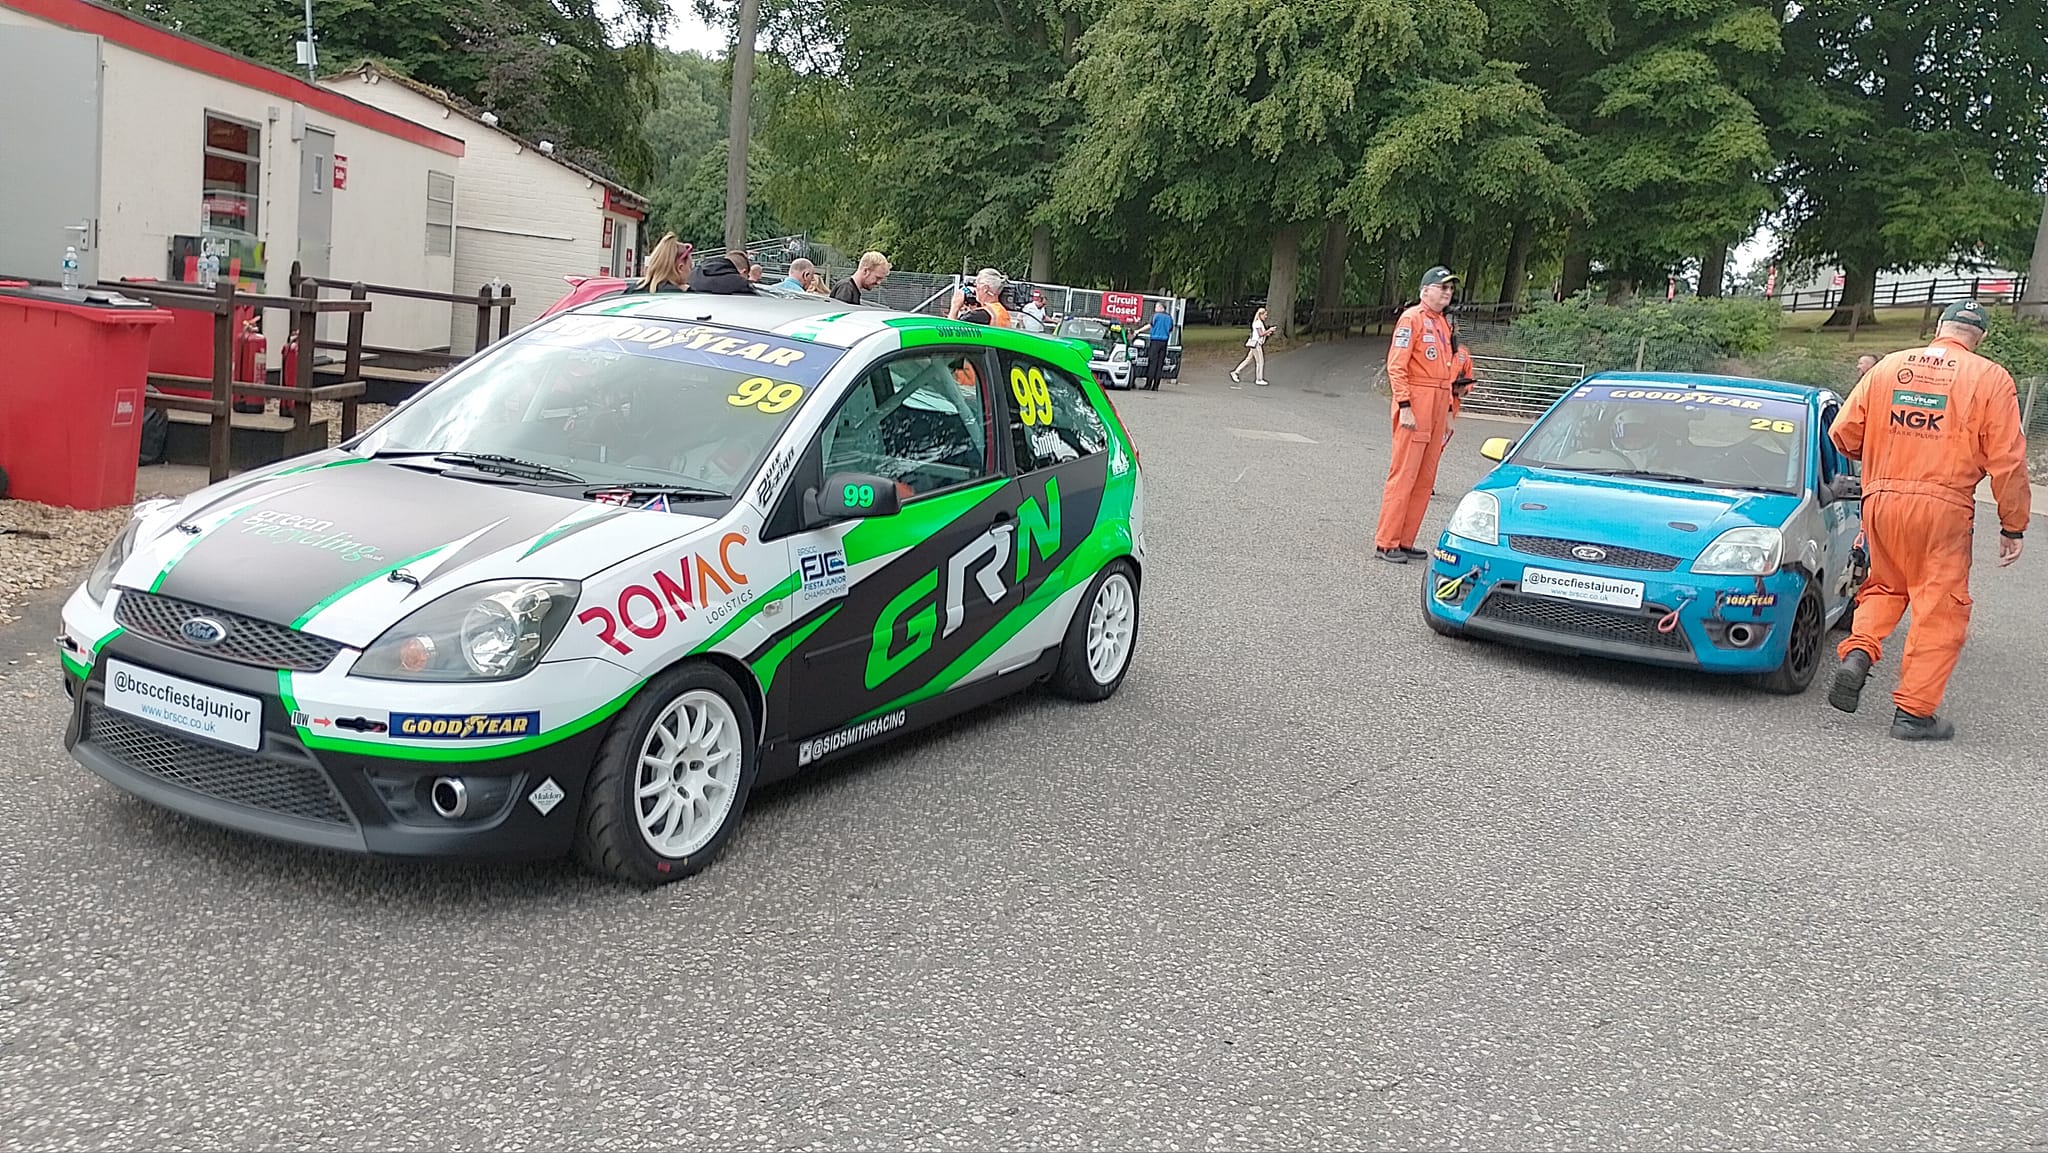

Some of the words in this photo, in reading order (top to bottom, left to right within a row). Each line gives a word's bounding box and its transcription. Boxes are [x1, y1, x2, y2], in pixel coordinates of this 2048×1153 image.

[1106, 305, 1137, 316] Closed
[1108, 294, 1138, 305] Circuit
[727, 377, 805, 414] 99
[1010, 366, 1053, 427] 99
[1609, 390, 1763, 410] GOODYEAR
[1749, 418, 1795, 434] 26
[1889, 409, 1945, 432] NGK
[1031, 428, 1061, 457] Smith
[843, 483, 876, 508] 99
[242, 509, 334, 533] green
[240, 522, 381, 562] recycling
[804, 580, 824, 591] FIESTA
[825, 575, 847, 587] JUNIOR
[804, 584, 847, 601] CHAMPIONSHIP
[865, 475, 1061, 690] GRN
[1528, 572, 1636, 596] @brsccfiestajunior
[1551, 588, 1609, 601] www.brscc.co.uk
[705, 588, 754, 625] LOGISTICS
[184, 621, 217, 640] Ford
[114, 671, 251, 724] @brsccfiestajunior
[141, 703, 217, 734] www.brscc.co.uk
[293, 711, 310, 726] TOW
[402, 716, 528, 737] GOODYEAR
[812, 709, 906, 760] @SIDSMITHRACING
